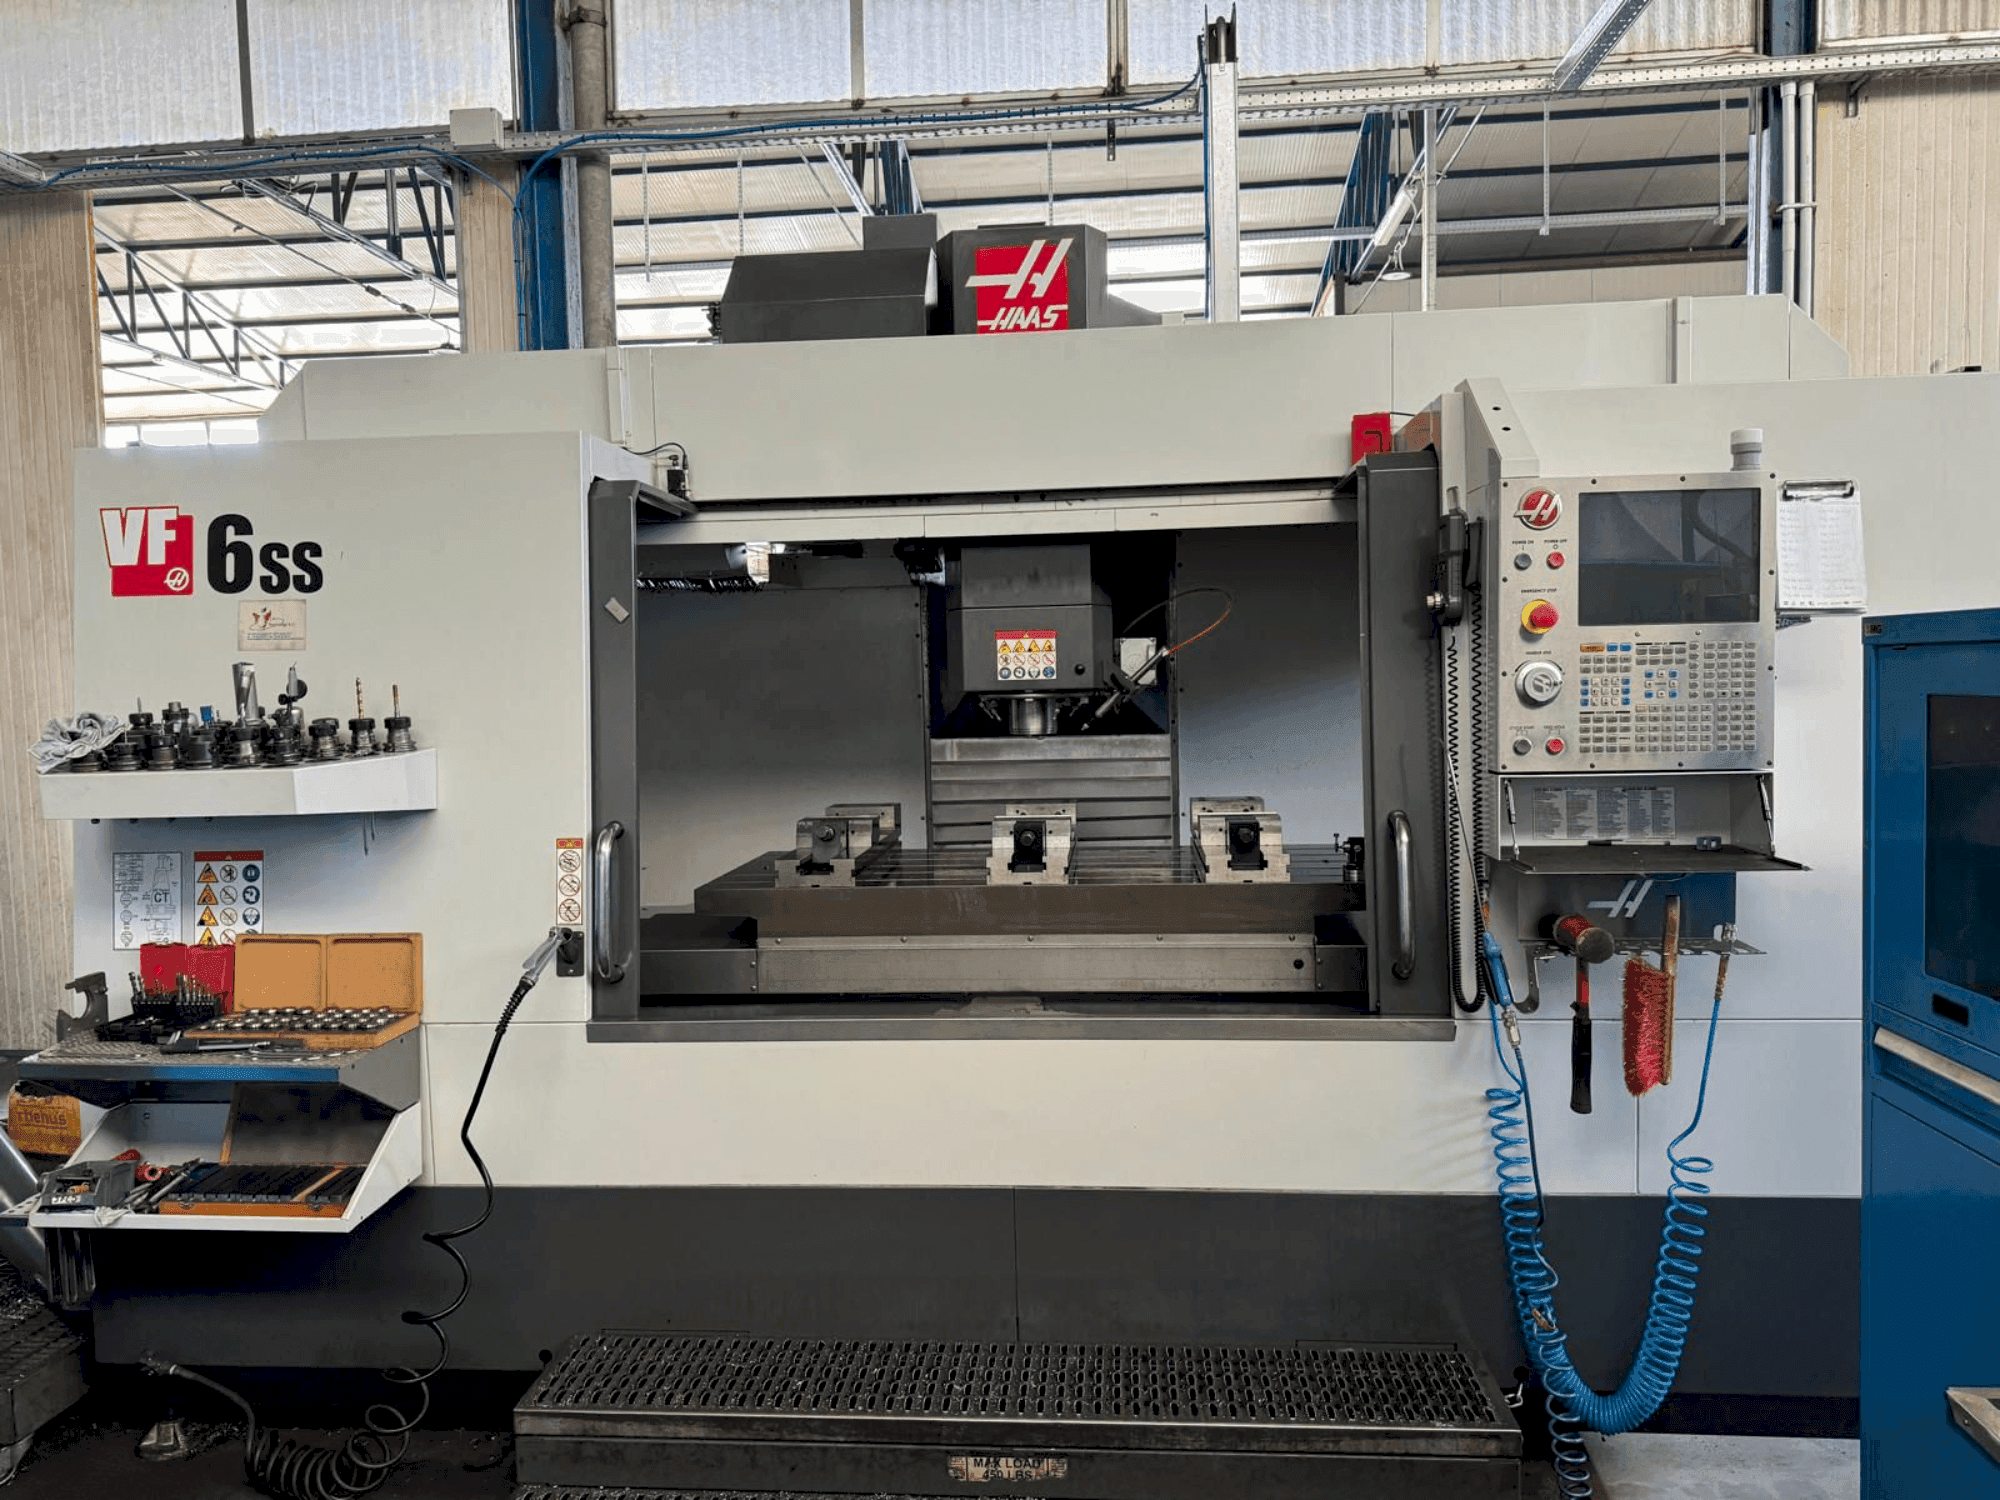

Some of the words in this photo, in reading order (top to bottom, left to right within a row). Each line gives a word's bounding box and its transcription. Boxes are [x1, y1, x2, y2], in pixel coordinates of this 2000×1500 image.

[976, 304, 1069, 331] HAAS
[100, 506, 179, 568] VF
[154, 891, 170, 903] CT
[973, 1457, 1001, 1469] MAX
[1005, 1457, 1042, 1470] LOAD
[1007, 1469, 1033, 1481] LBS
